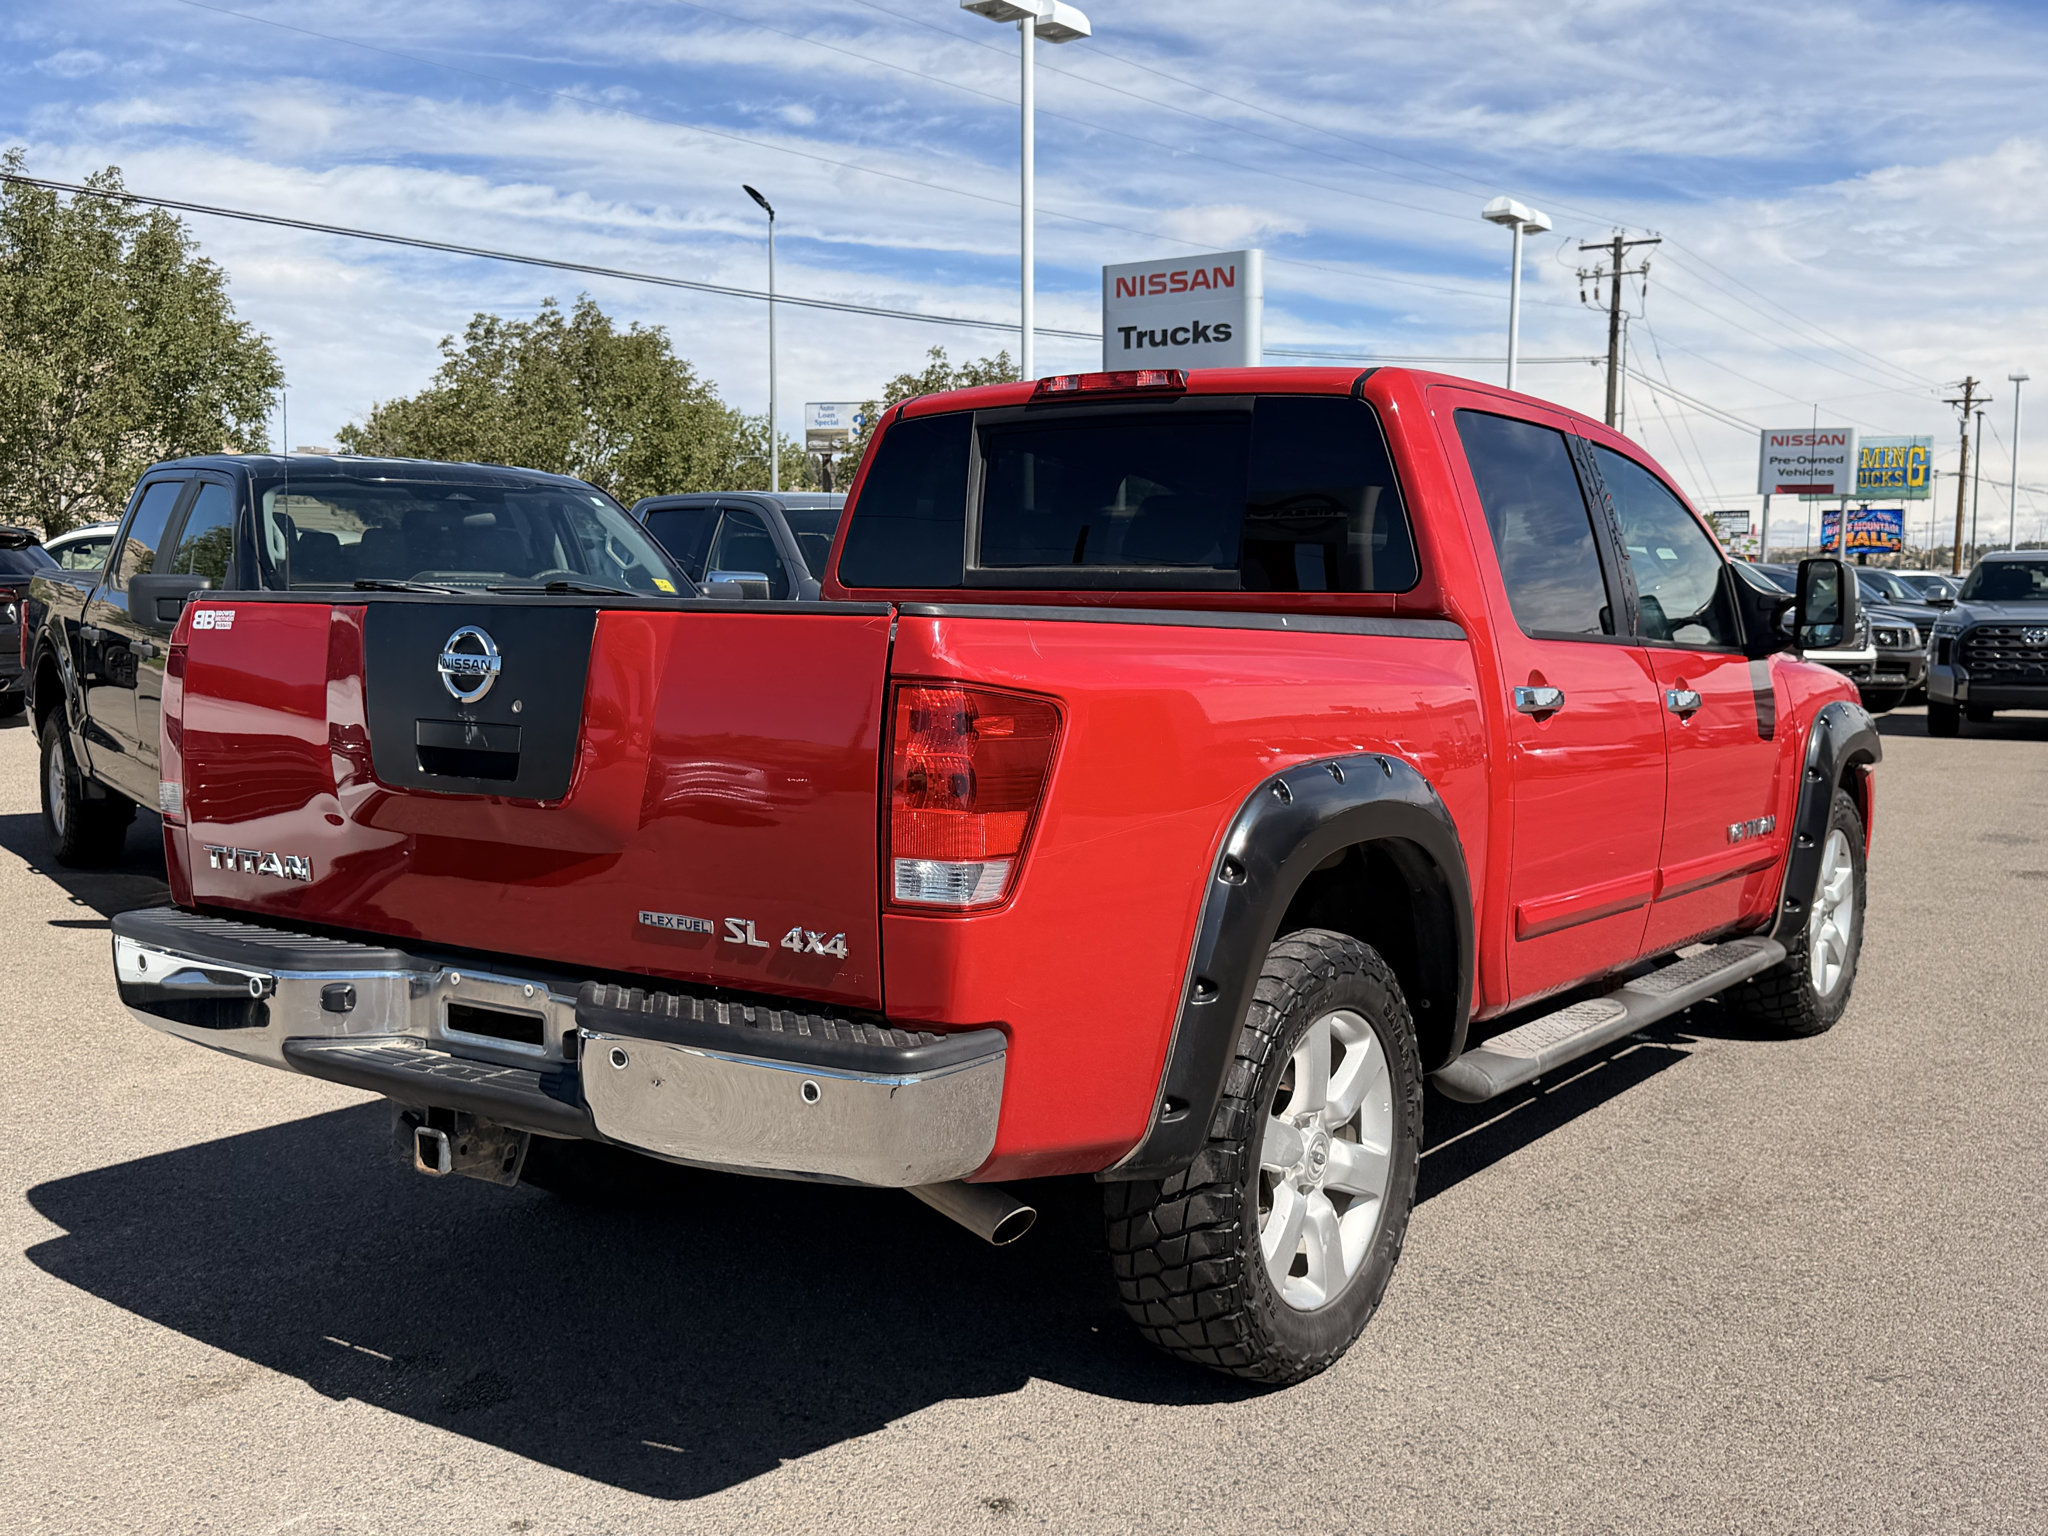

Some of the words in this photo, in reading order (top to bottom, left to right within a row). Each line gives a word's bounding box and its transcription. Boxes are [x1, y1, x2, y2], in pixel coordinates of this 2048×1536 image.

[1116, 266, 1235, 298] NISSAN
[1118, 320, 1232, 350] Trucks
[814, 419, 839, 427] Special
[1770, 434, 1846, 447] NISSAN
[1769, 455, 1844, 464] Pre-Owned
[1777, 468, 1835, 477] Vehicles
[1854, 521, 1899, 534] MOUNTAIN
[1832, 531, 1893, 548] MALL
[442, 658, 491, 671] NISSAN
[203, 844, 312, 881] TITAN
[642, 913, 674, 928] FLEX
[676, 918, 709, 933] FUEL
[723, 917, 770, 948] SL
